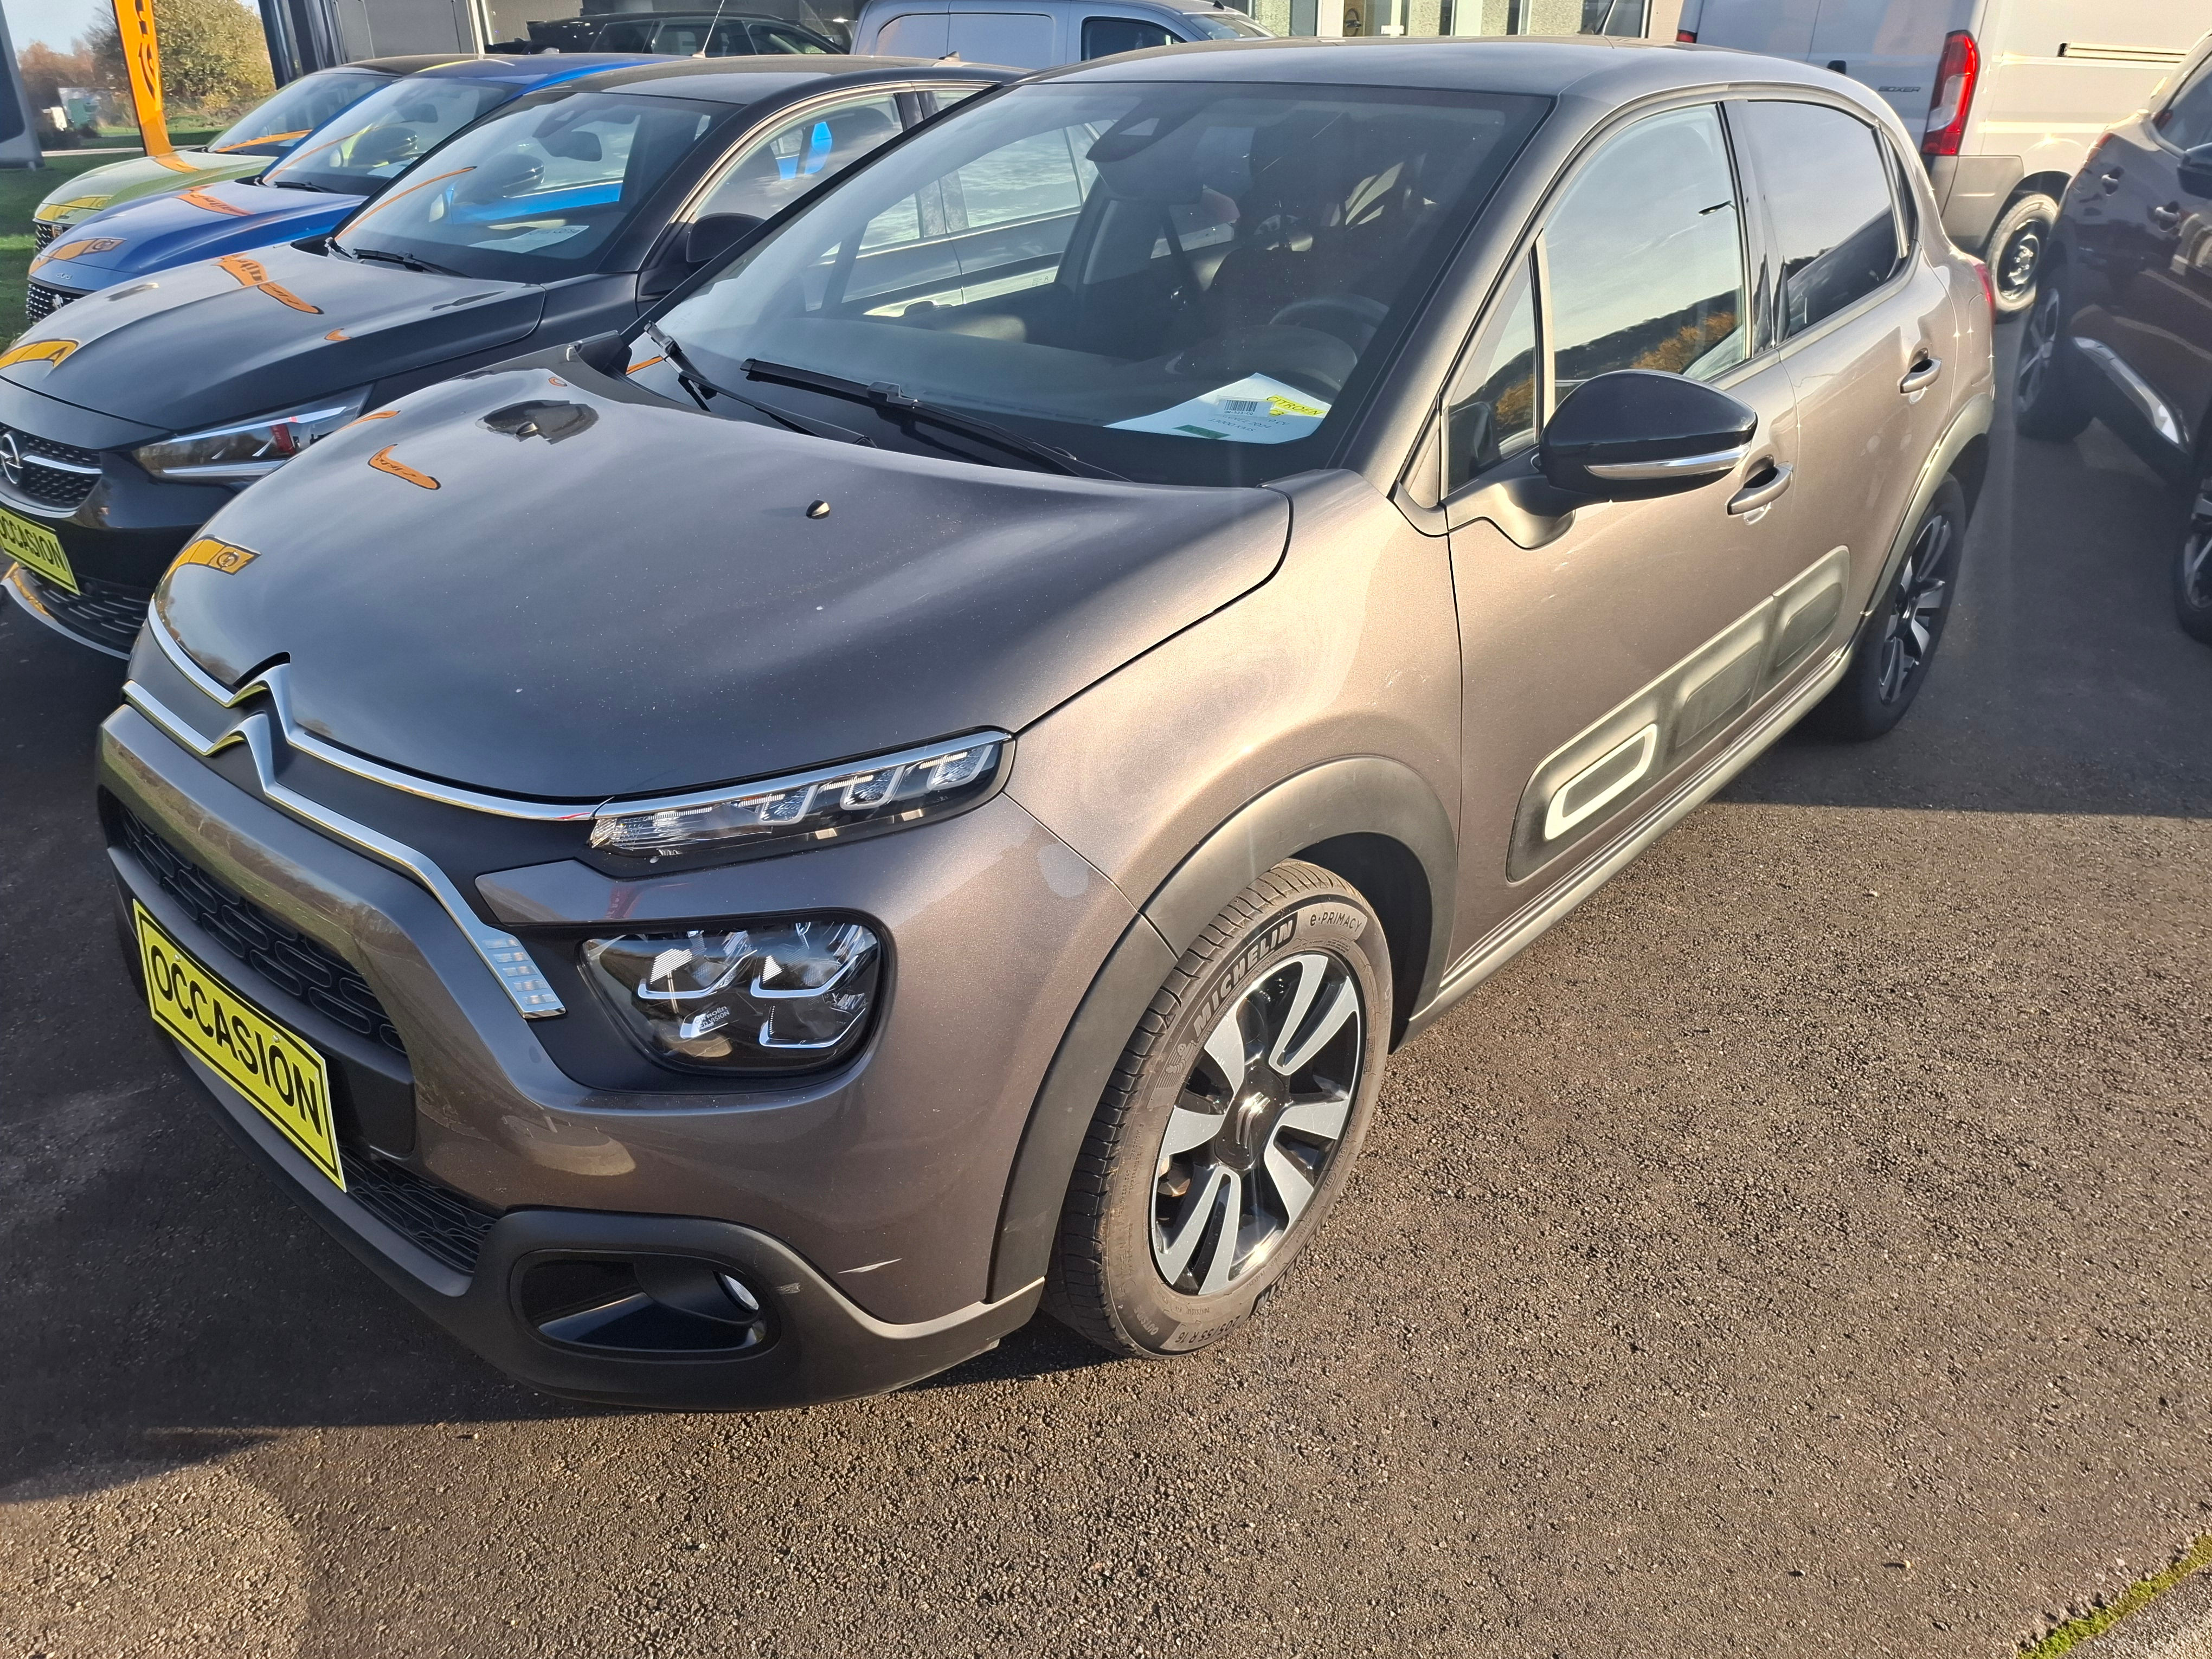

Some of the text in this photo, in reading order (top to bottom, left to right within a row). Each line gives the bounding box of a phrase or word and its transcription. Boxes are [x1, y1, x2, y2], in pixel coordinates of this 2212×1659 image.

[1266, 396, 1323, 415] CITROEN
[1194, 919, 1293, 1038] MICHELIN
[708, 1010, 730, 1023] VISION
[151, 944, 323, 1138] OCCASION
[1133, 1304, 1159, 1335] OUTSIDE
[1175, 1332, 1189, 1343] 16
